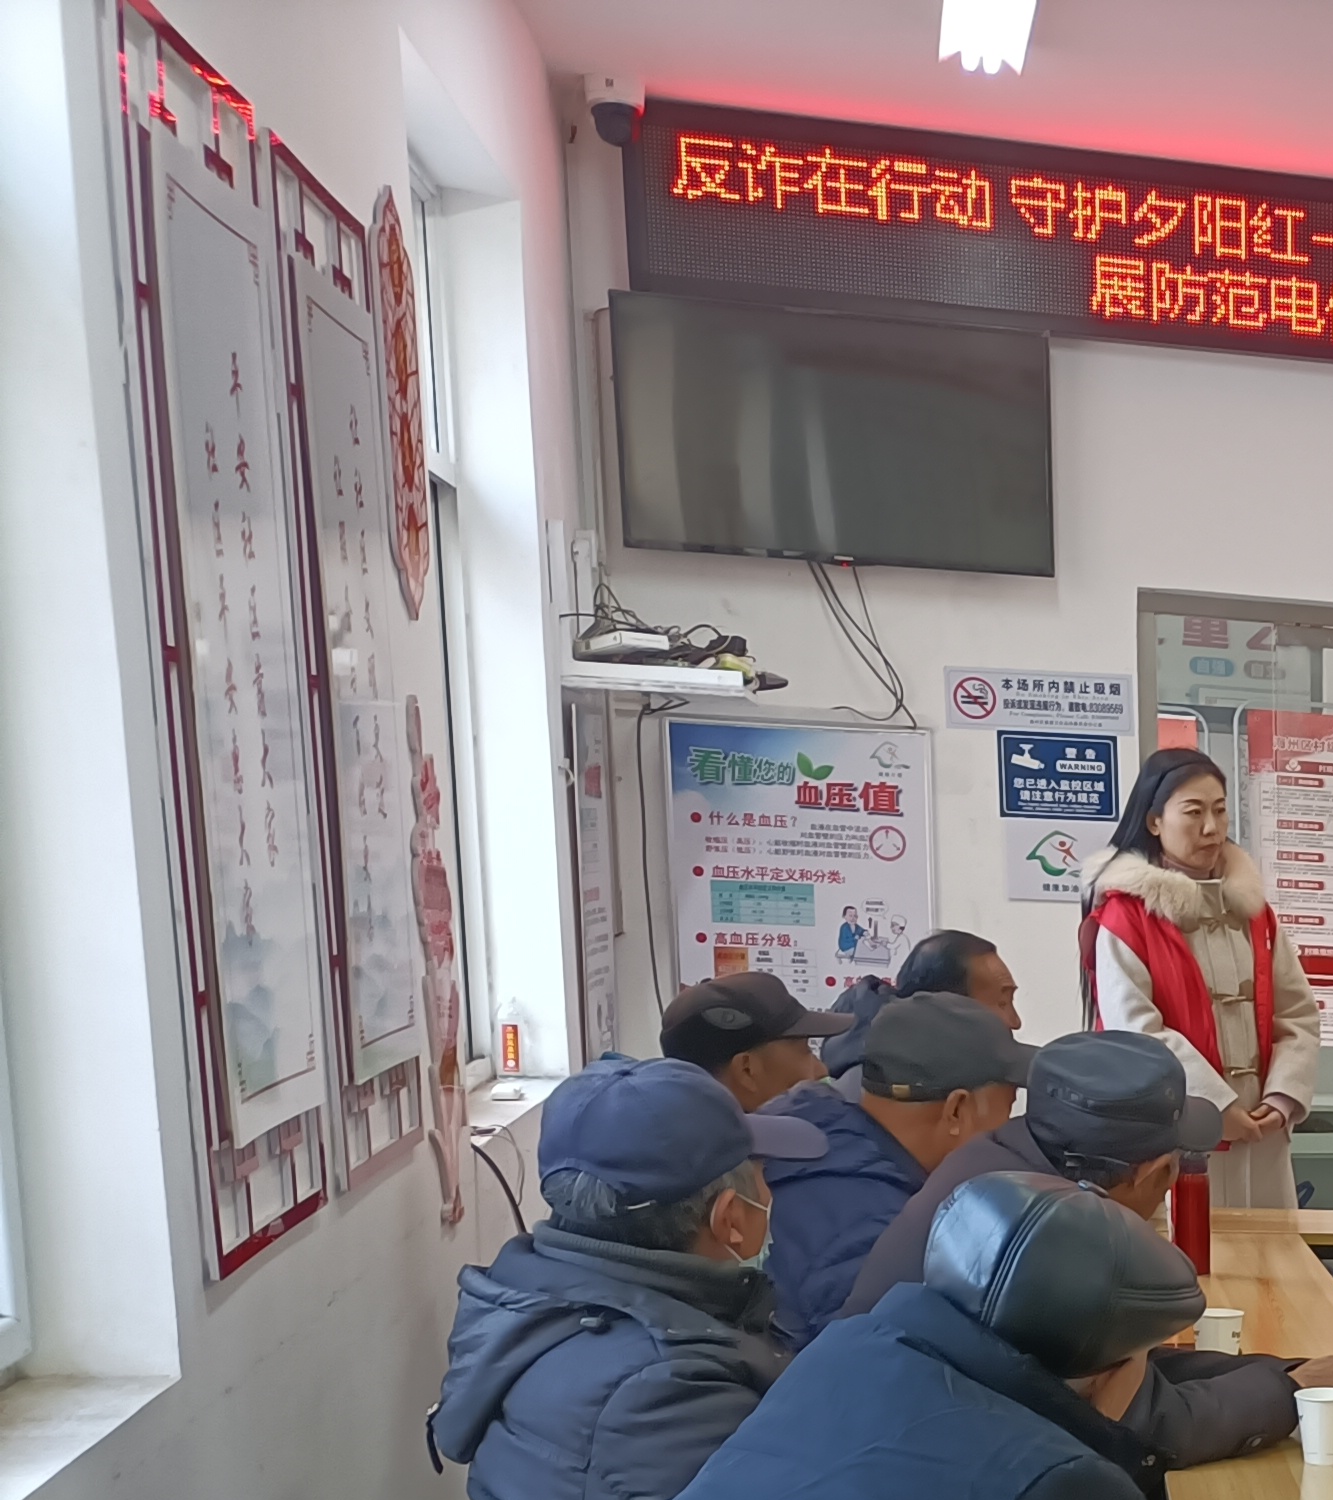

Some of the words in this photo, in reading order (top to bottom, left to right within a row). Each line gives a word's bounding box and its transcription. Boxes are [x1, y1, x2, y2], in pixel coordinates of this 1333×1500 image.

[672, 134, 992, 230] 反诈在行动
[1001, 677, 1121, 696] 本场所内禁止吸烟
[688, 747, 795, 785] 看懂您的
[1059, 763, 1103, 772] WARNING
[1013, 777, 1105, 792] 您已进入监控区域
[795, 781, 903, 816] 血压值
[1019, 790, 1100, 804] 请注意行为规范
